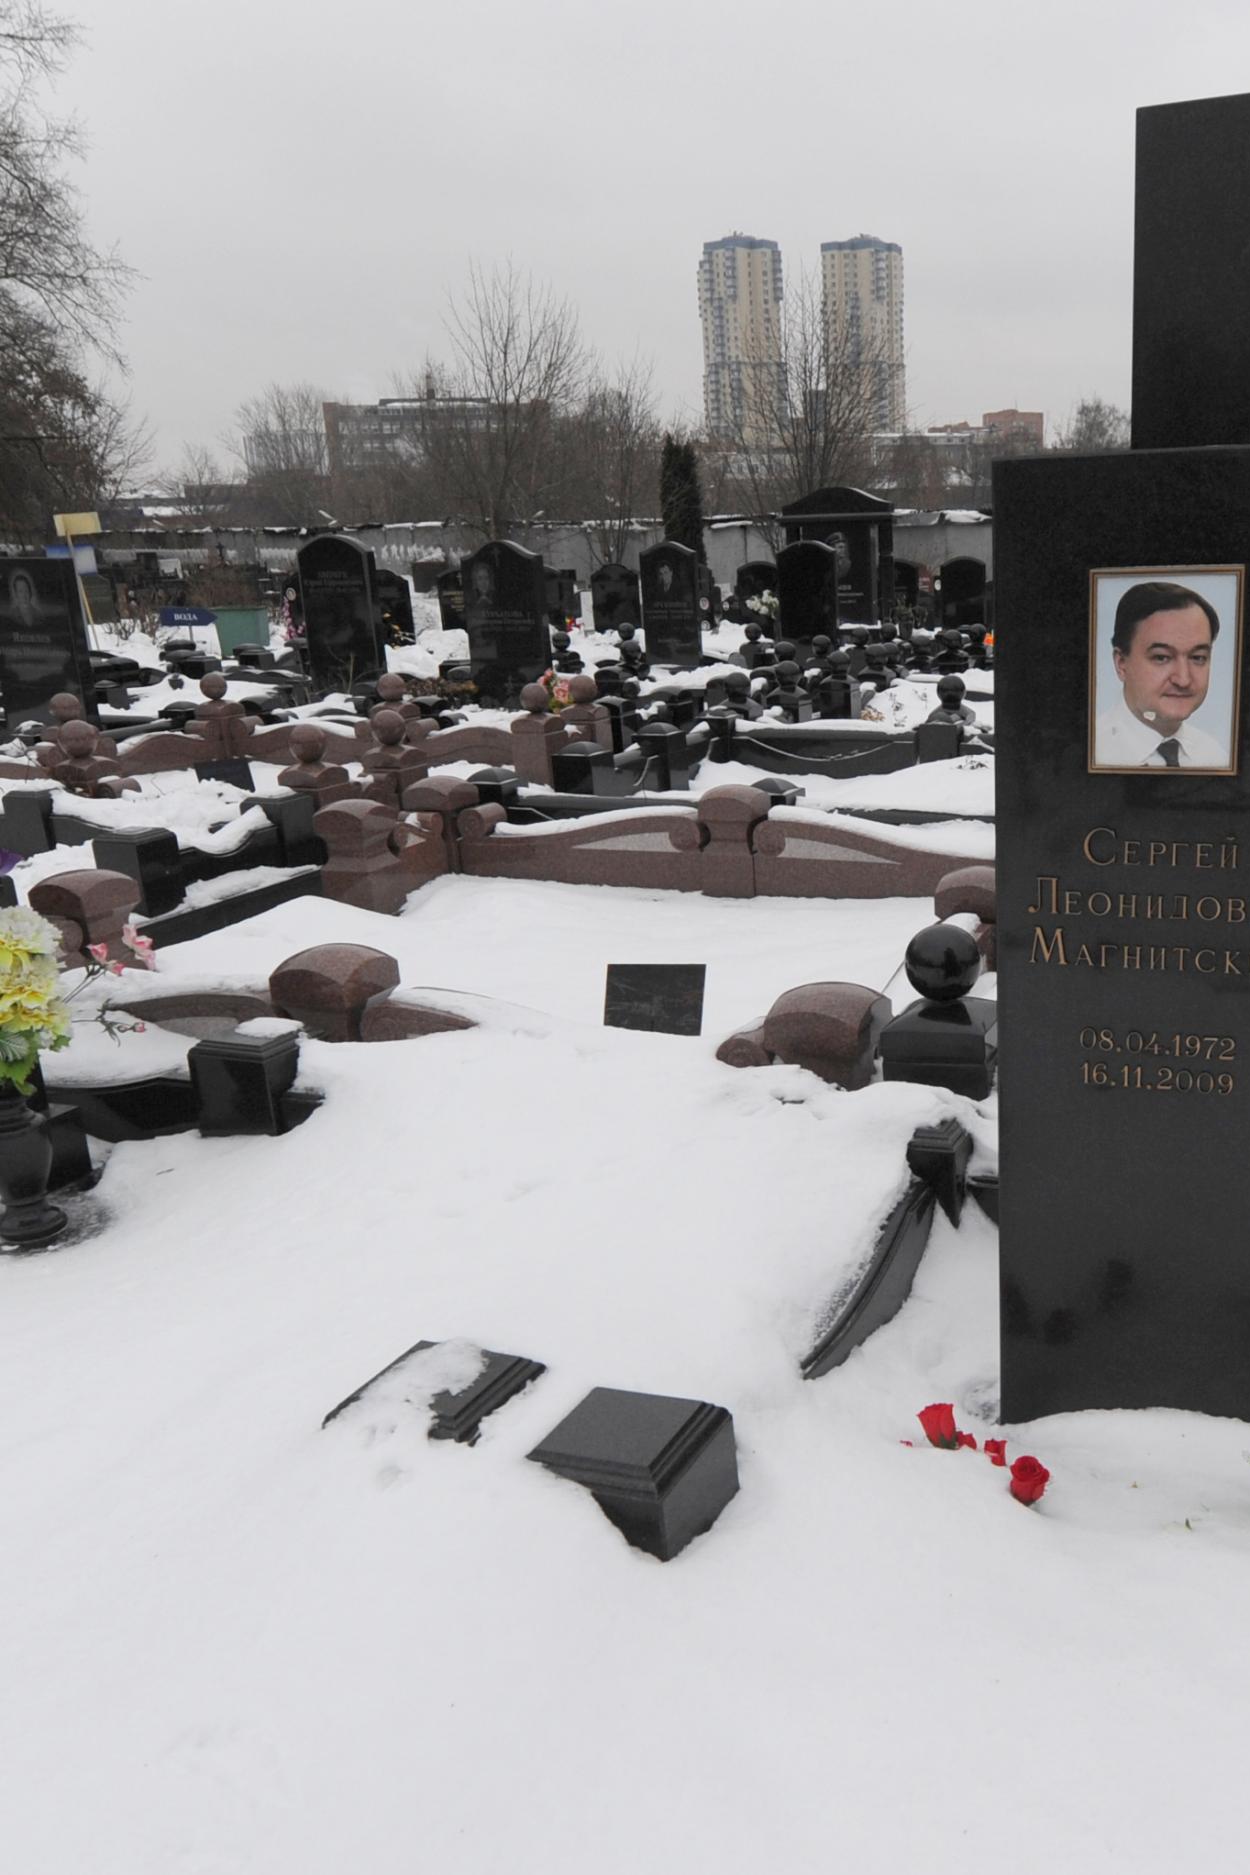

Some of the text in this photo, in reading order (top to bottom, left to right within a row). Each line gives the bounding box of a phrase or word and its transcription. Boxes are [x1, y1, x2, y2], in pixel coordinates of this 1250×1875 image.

[173, 613, 198, 621] ВОДА
[1079, 1026, 1237, 1061] 08.04.1972
[1080, 1062, 1234, 1095] 16.11.2009
